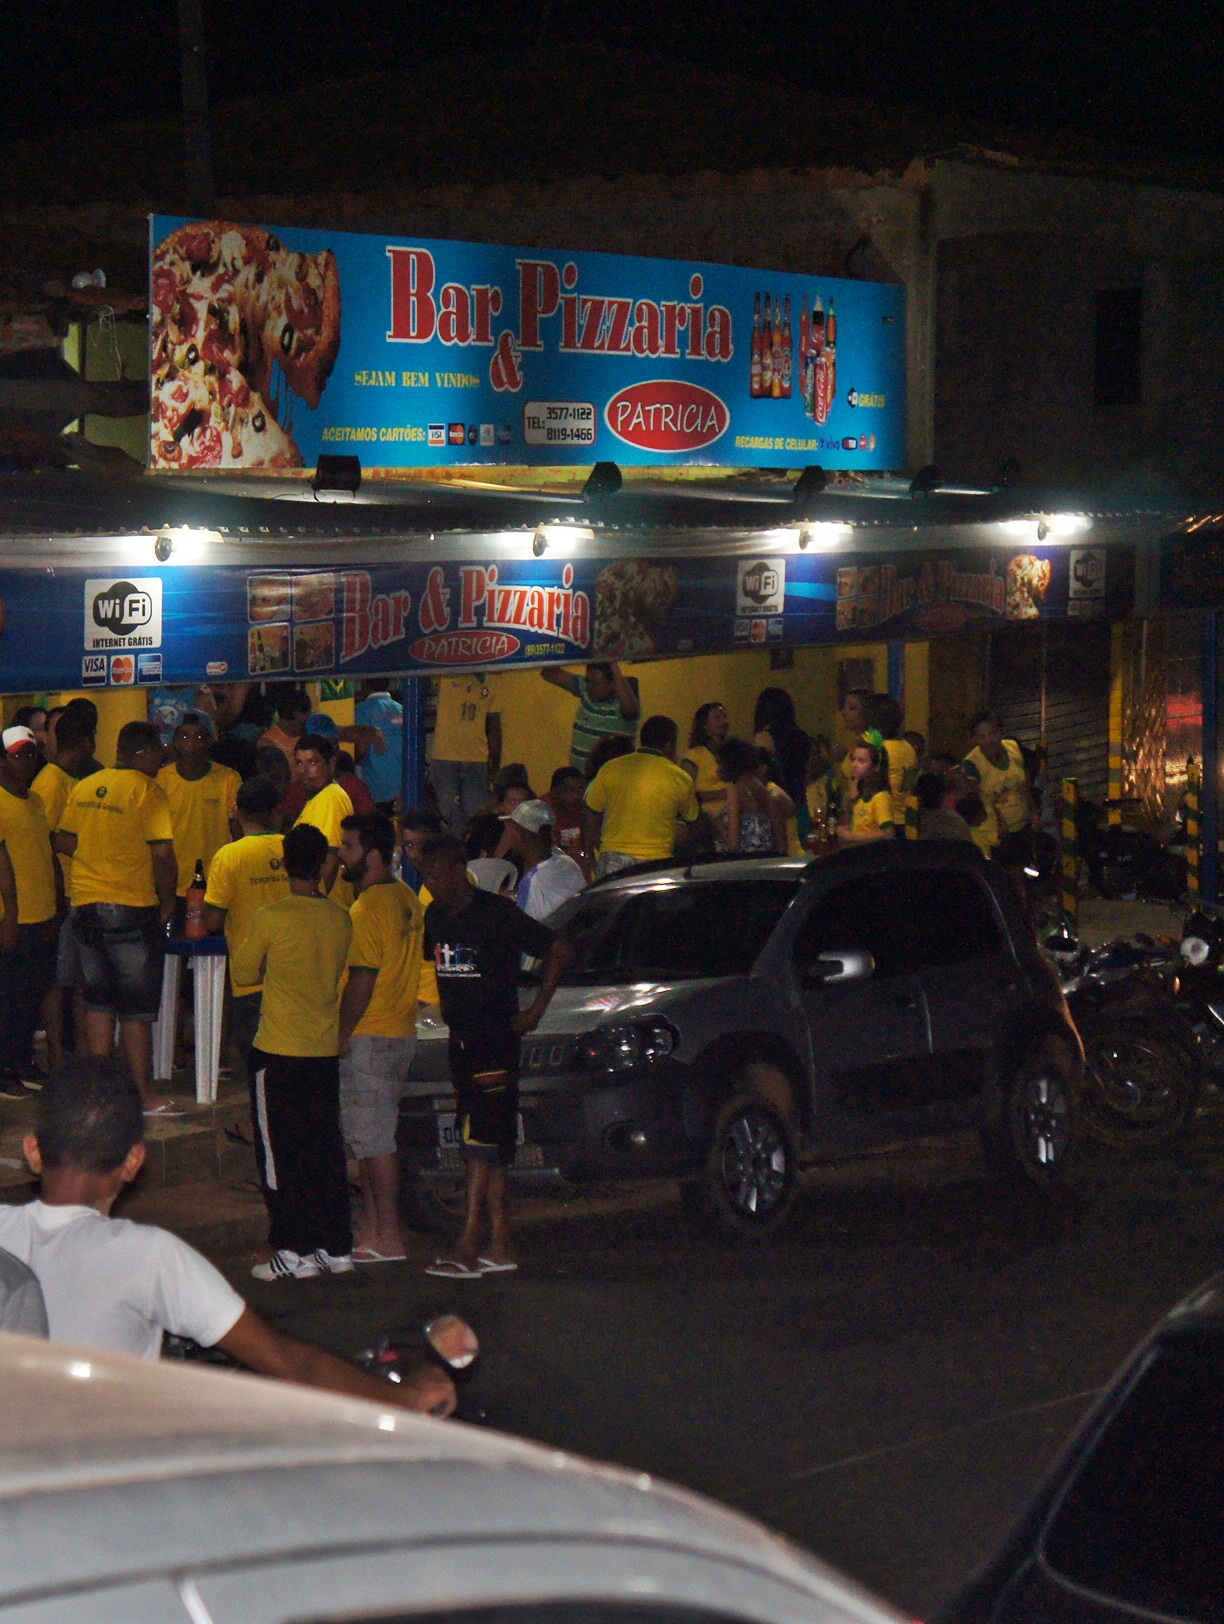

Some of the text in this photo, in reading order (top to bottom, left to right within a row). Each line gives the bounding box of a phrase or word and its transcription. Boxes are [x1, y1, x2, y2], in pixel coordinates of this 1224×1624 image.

[386, 245, 734, 392] Bar & Pizzaria
[354, 370, 480, 388] SEJAM BEM VINDOS
[527, 407, 592, 429] TEL: 3577-1122
[617, 402, 720, 433] PATRICIA
[322, 424, 426, 442] ACEITAMOS CARTÕES:
[546, 427, 593, 441] 8119-1466
[339, 563, 590, 664] Bar & Pizzaria
[93, 636, 153, 648] INTERNET GRÁTIS
[425, 635, 508, 658] PATRICIA
[84, 658, 105, 673] VISA
